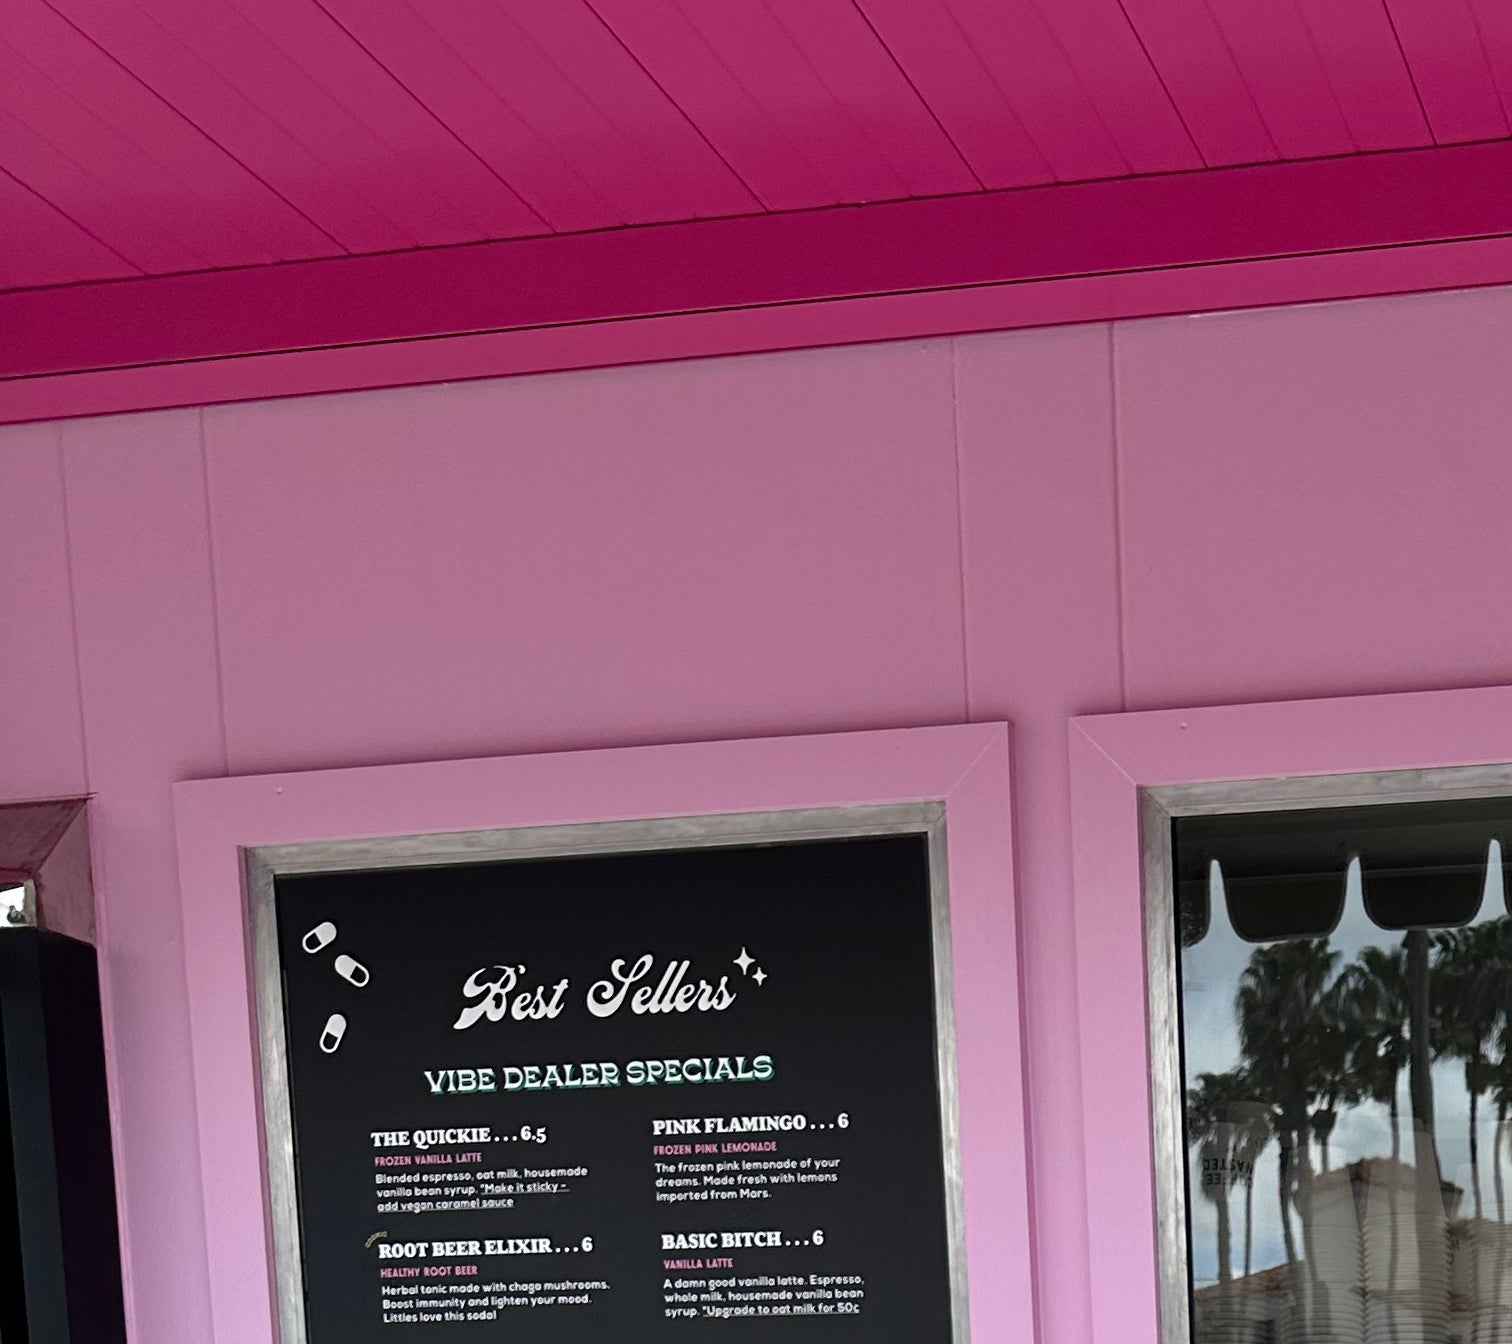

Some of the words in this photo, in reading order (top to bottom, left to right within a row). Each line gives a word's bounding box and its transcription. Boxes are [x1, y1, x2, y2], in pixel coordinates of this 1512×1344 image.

[453, 964, 570, 1030] Best
[586, 954, 737, 1019] Sellers
[424, 1067, 497, 1095] VIBE
[503, 1061, 620, 1092] DEALER
[626, 1056, 774, 1087] SPECIALS
[652, 1118, 702, 1135] PINK
[704, 1114, 806, 1133] FLAMINGO
[837, 1113, 850, 1129] 6
[370, 1131, 410, 1147] THE
[413, 1127, 491, 1149] QUICKIE
[520, 1126, 547, 1144] 6.5
[653, 1144, 692, 1155] FROZEN
[695, 1144, 718, 1154] PINK
[721, 1141, 777, 1153] LEMONADE
[375, 1156, 412, 1166] FROZEN
[414, 1154, 453, 1165] VANILLA
[456, 1152, 482, 1163] LATTE
[654, 1163, 676, 1173] The
[678, 1162, 714, 1172] frozen
[716, 1161, 740, 1173] pink
[742, 1158, 798, 1170] lemonade
[800, 1158, 812, 1168] of
[814, 1159, 840, 1170] your
[375, 1172, 420, 1184] Blended
[476, 1170, 495, 1180] oat
[524, 1166, 588, 1178] housemade
[703, 1175, 735, 1186] Made
[737, 1174, 767, 1184] fresh
[769, 1173, 795, 1184] with
[797, 1172, 838, 1183] lemons
[656, 1190, 708, 1203] imported
[710, 1189, 738, 1199] from
[661, 1233, 718, 1250] BASIC
[721, 1231, 782, 1248] BITCH
[812, 1230, 824, 1246] 6
[378, 1242, 429, 1259] ROOT
[431, 1240, 482, 1257] BEER
[484, 1238, 553, 1255] ELIXIR
[581, 1236, 593, 1252] 6
[664, 1259, 703, 1269] VANILLA
[706, 1258, 733, 1268] LATTE
[380, 1268, 420, 1278] HEALTHY
[423, 1266, 452, 1276] ROOT
[455, 1265, 478, 1276] BEER
[381, 1285, 419, 1295] Herbal
[420, 1284, 448, 1294] tonic
[449, 1283, 480, 1293] made
[482, 1282, 507, 1292] with
[508, 1282, 542, 1295] chaga
[383, 1313, 418, 1323] Littles
[419, 1312, 442, 1322] love
[444, 1311, 465, 1321] this
